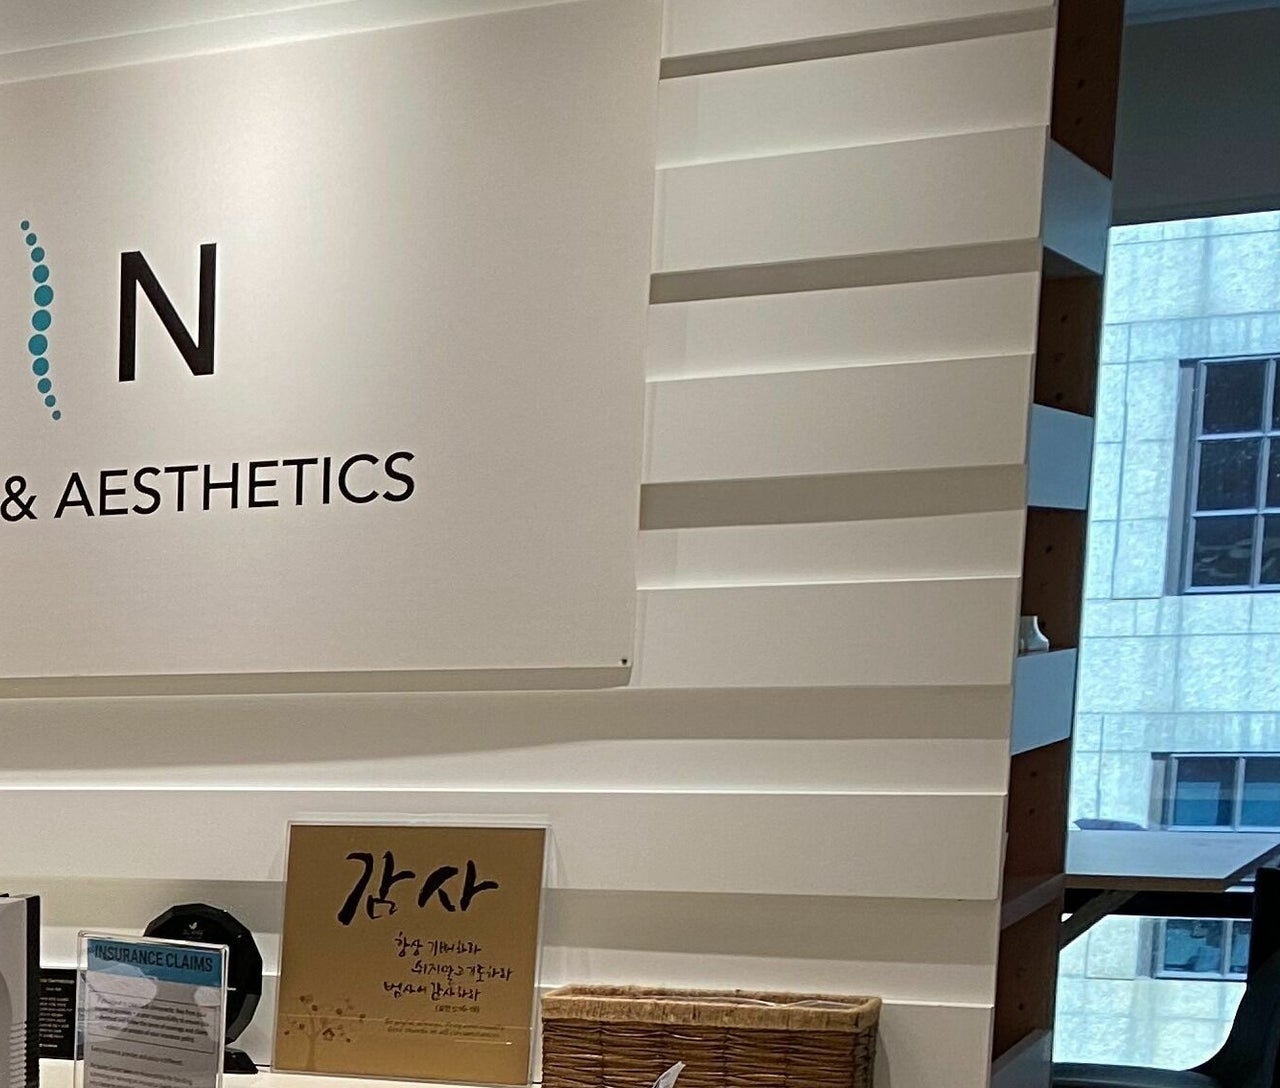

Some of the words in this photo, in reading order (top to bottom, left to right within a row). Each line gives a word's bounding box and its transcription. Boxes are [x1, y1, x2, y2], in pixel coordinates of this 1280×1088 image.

[53, 451, 416, 518] AESTHETICS
[337, 851, 499, 926] 감사
[95, 944, 164, 967] INSURANCE
[166, 952, 213, 972] CLAIMS
